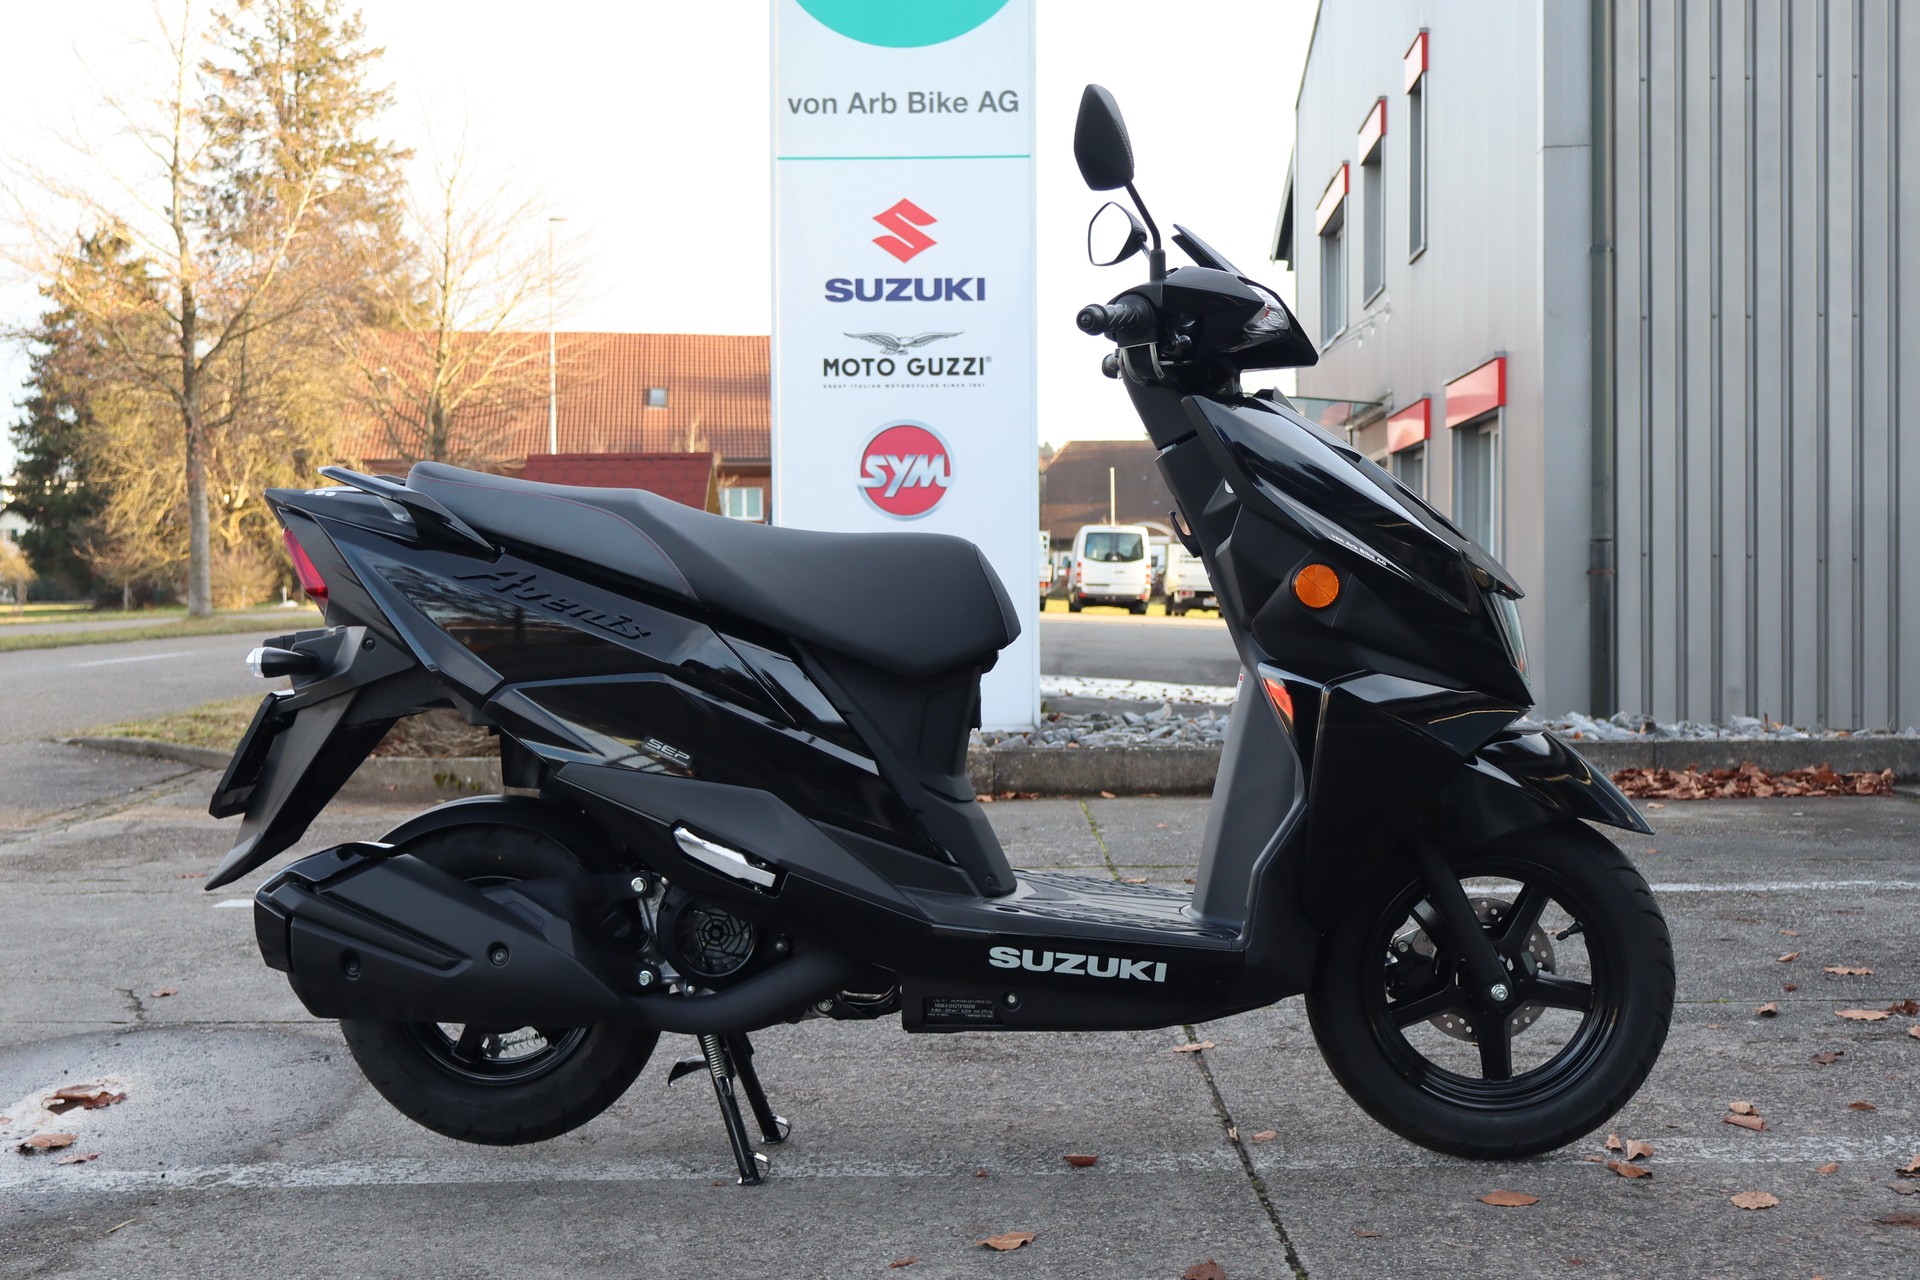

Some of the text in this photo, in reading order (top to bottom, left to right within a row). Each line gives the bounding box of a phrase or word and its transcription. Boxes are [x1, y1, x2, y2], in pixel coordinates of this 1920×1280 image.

[788, 90, 1019, 114] von Arb Bike AG
[825, 278, 985, 302] SUZUKI
[823, 357, 984, 377] MOTO GUZZI
[857, 454, 951, 498] SYM
[646, 738, 690, 760] SEP
[988, 946, 1168, 983] SUZUKI
